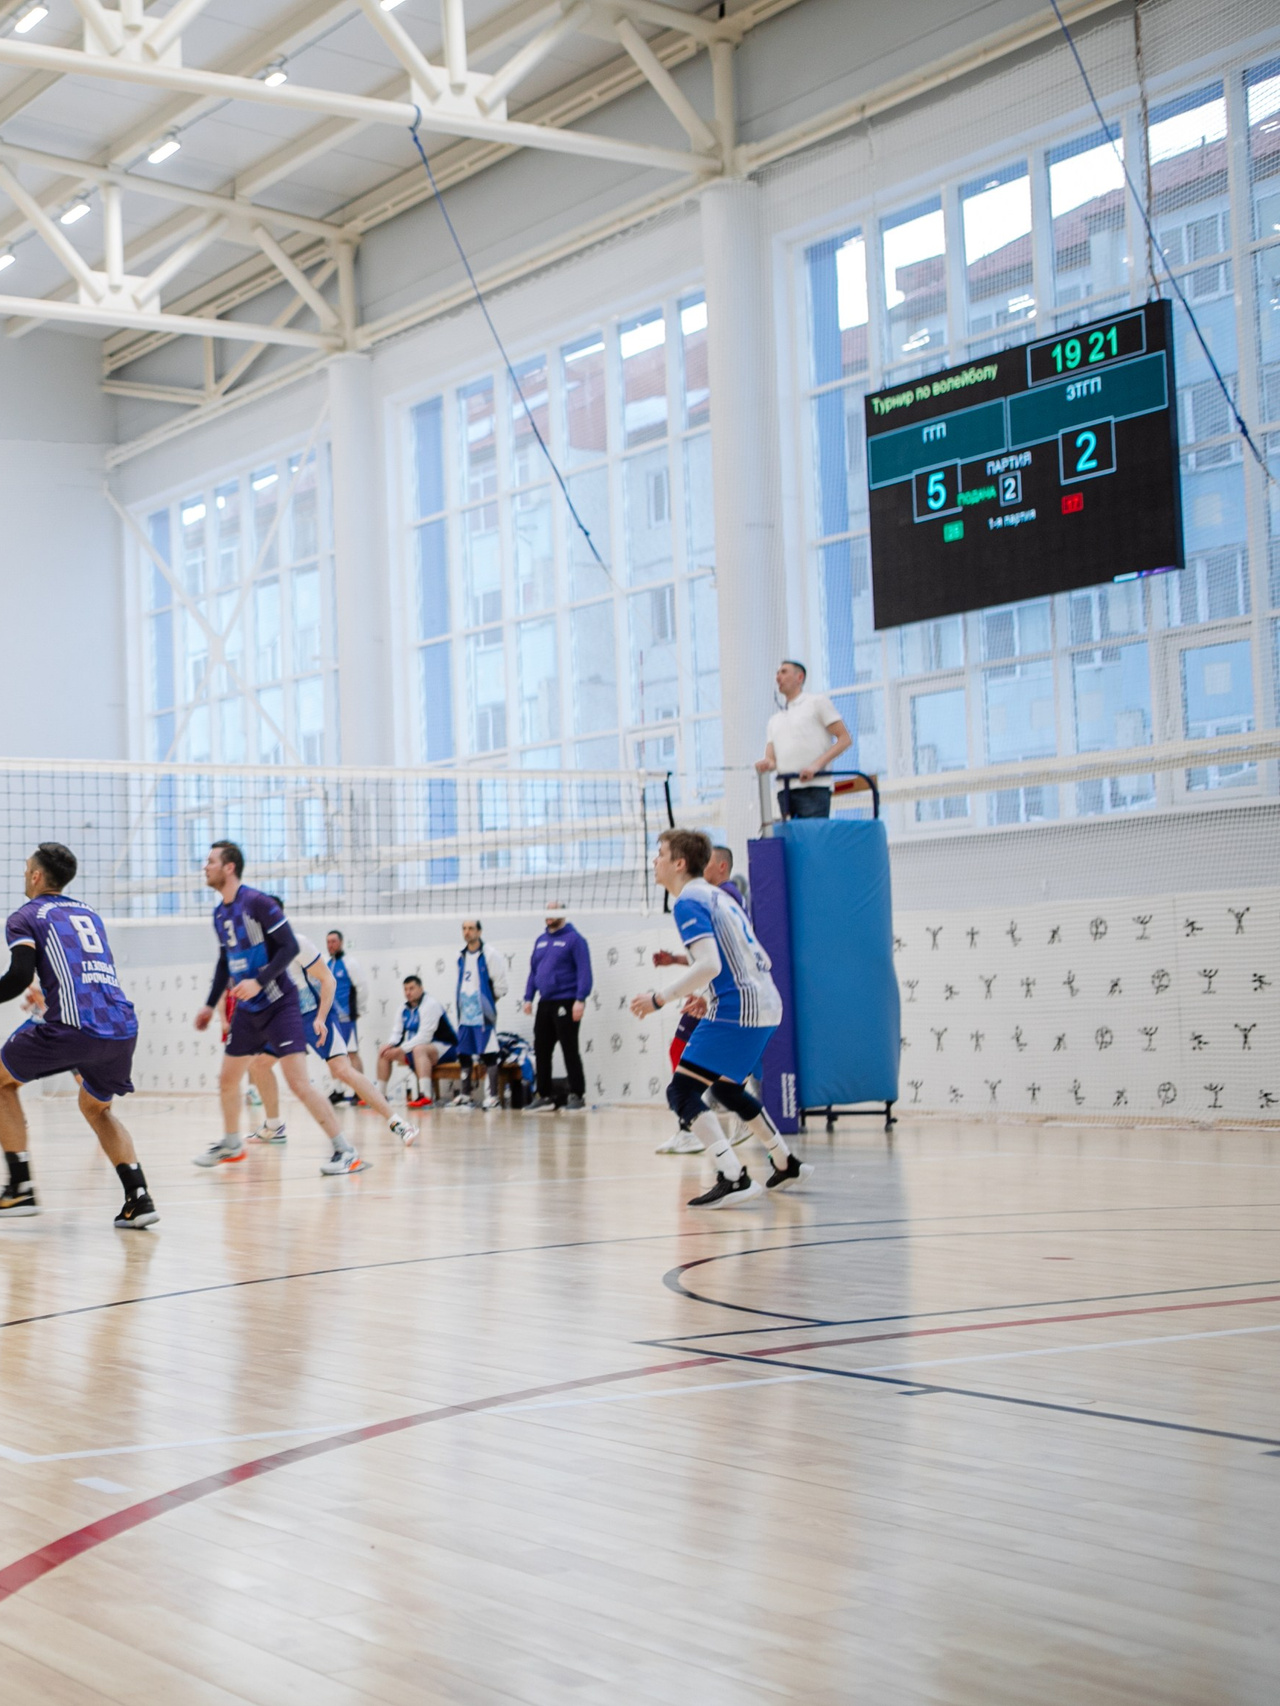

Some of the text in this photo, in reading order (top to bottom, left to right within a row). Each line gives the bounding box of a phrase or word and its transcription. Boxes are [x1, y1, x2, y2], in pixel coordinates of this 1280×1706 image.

[1051, 326, 1118, 373] 19 21
[871, 363, 998, 416] Турнир по волейболу
[922, 421, 946, 444] ГГП
[986, 451, 1032, 476] ПАРТИЯ
[1075, 431, 1098, 472] 2
[927, 471, 947, 510] 5
[1003, 477, 1017, 501] 2
[1003, 508, 1037, 528] партия
[69, 914, 104, 953] 8
[223, 919, 237, 947] 3
